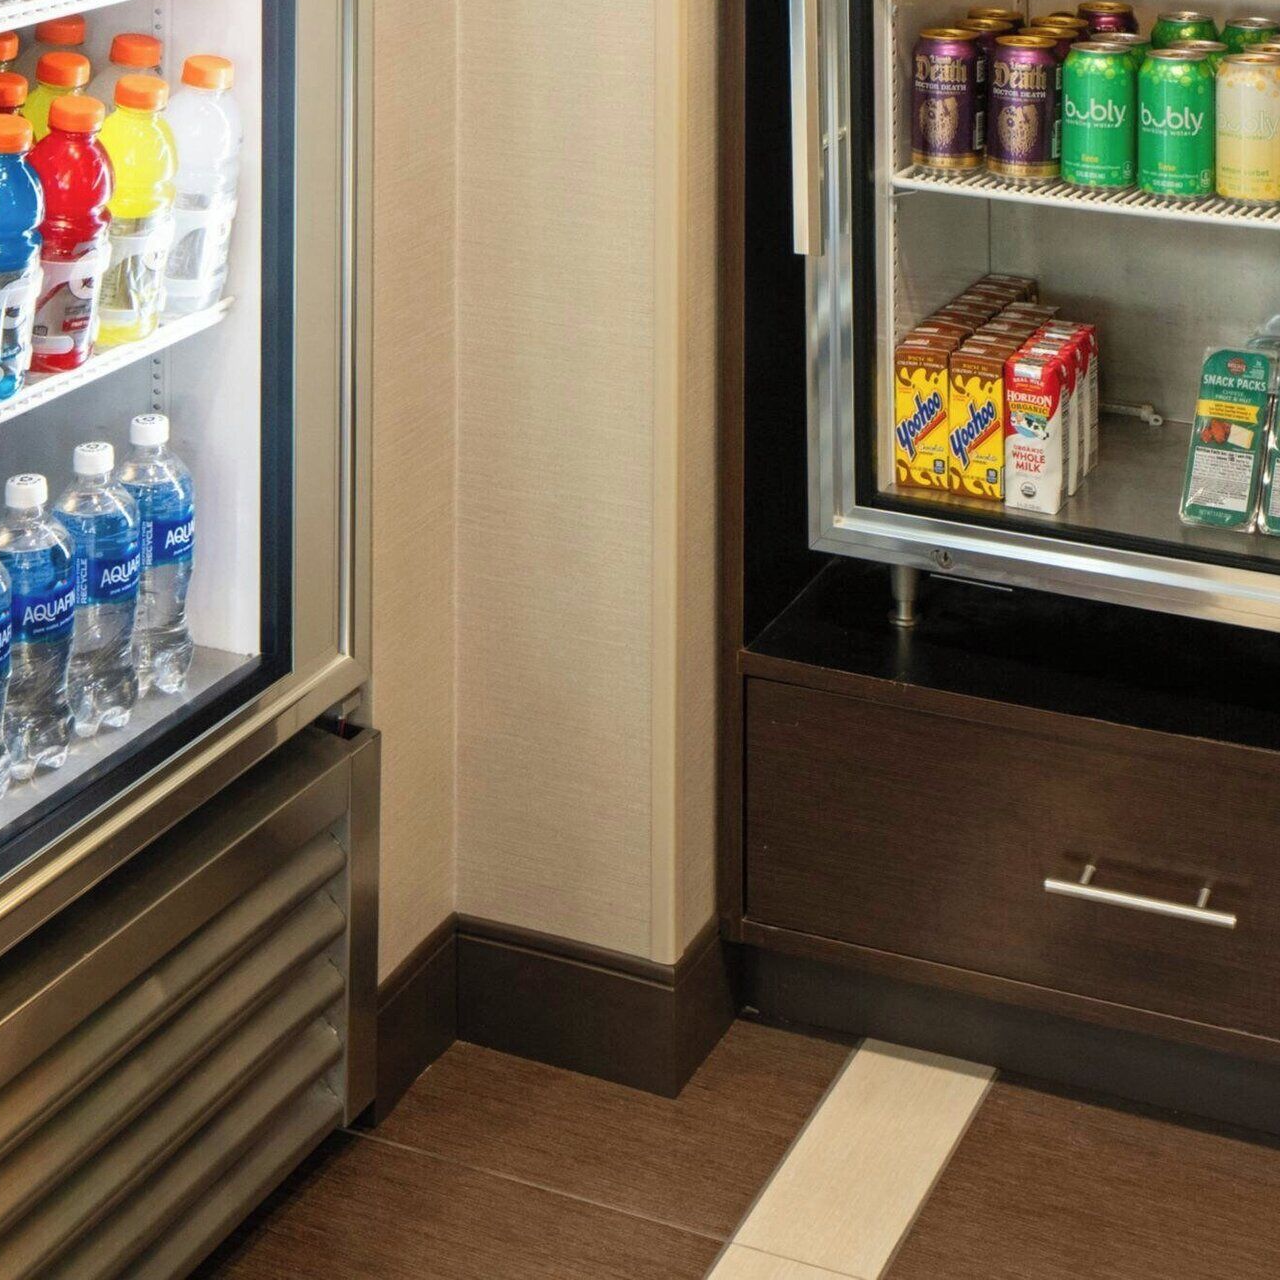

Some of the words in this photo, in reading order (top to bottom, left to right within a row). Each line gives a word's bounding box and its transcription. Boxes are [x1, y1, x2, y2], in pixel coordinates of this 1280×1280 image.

[916, 56, 967, 82] Death
[993, 61, 1047, 89] Death
[941, 83, 967, 91] DEATH
[993, 87, 1019, 97] DOCTOR
[1021, 89, 1047, 98] DEATH
[1065, 94, 1127, 128] bubly
[1141, 102, 1203, 136] bubly
[1203, 374, 1235, 387] SNACK
[1237, 377, 1267, 392] PACKS
[1007, 391, 1052, 406] HORIZON
[1010, 403, 1048, 415] ORGANIC
[1013, 445, 1043, 454] ORGANIC
[1011, 451, 1045, 464] WHOLE
[1015, 461, 1041, 473] MILK
[80, 558, 88, 604] RECYCLE
